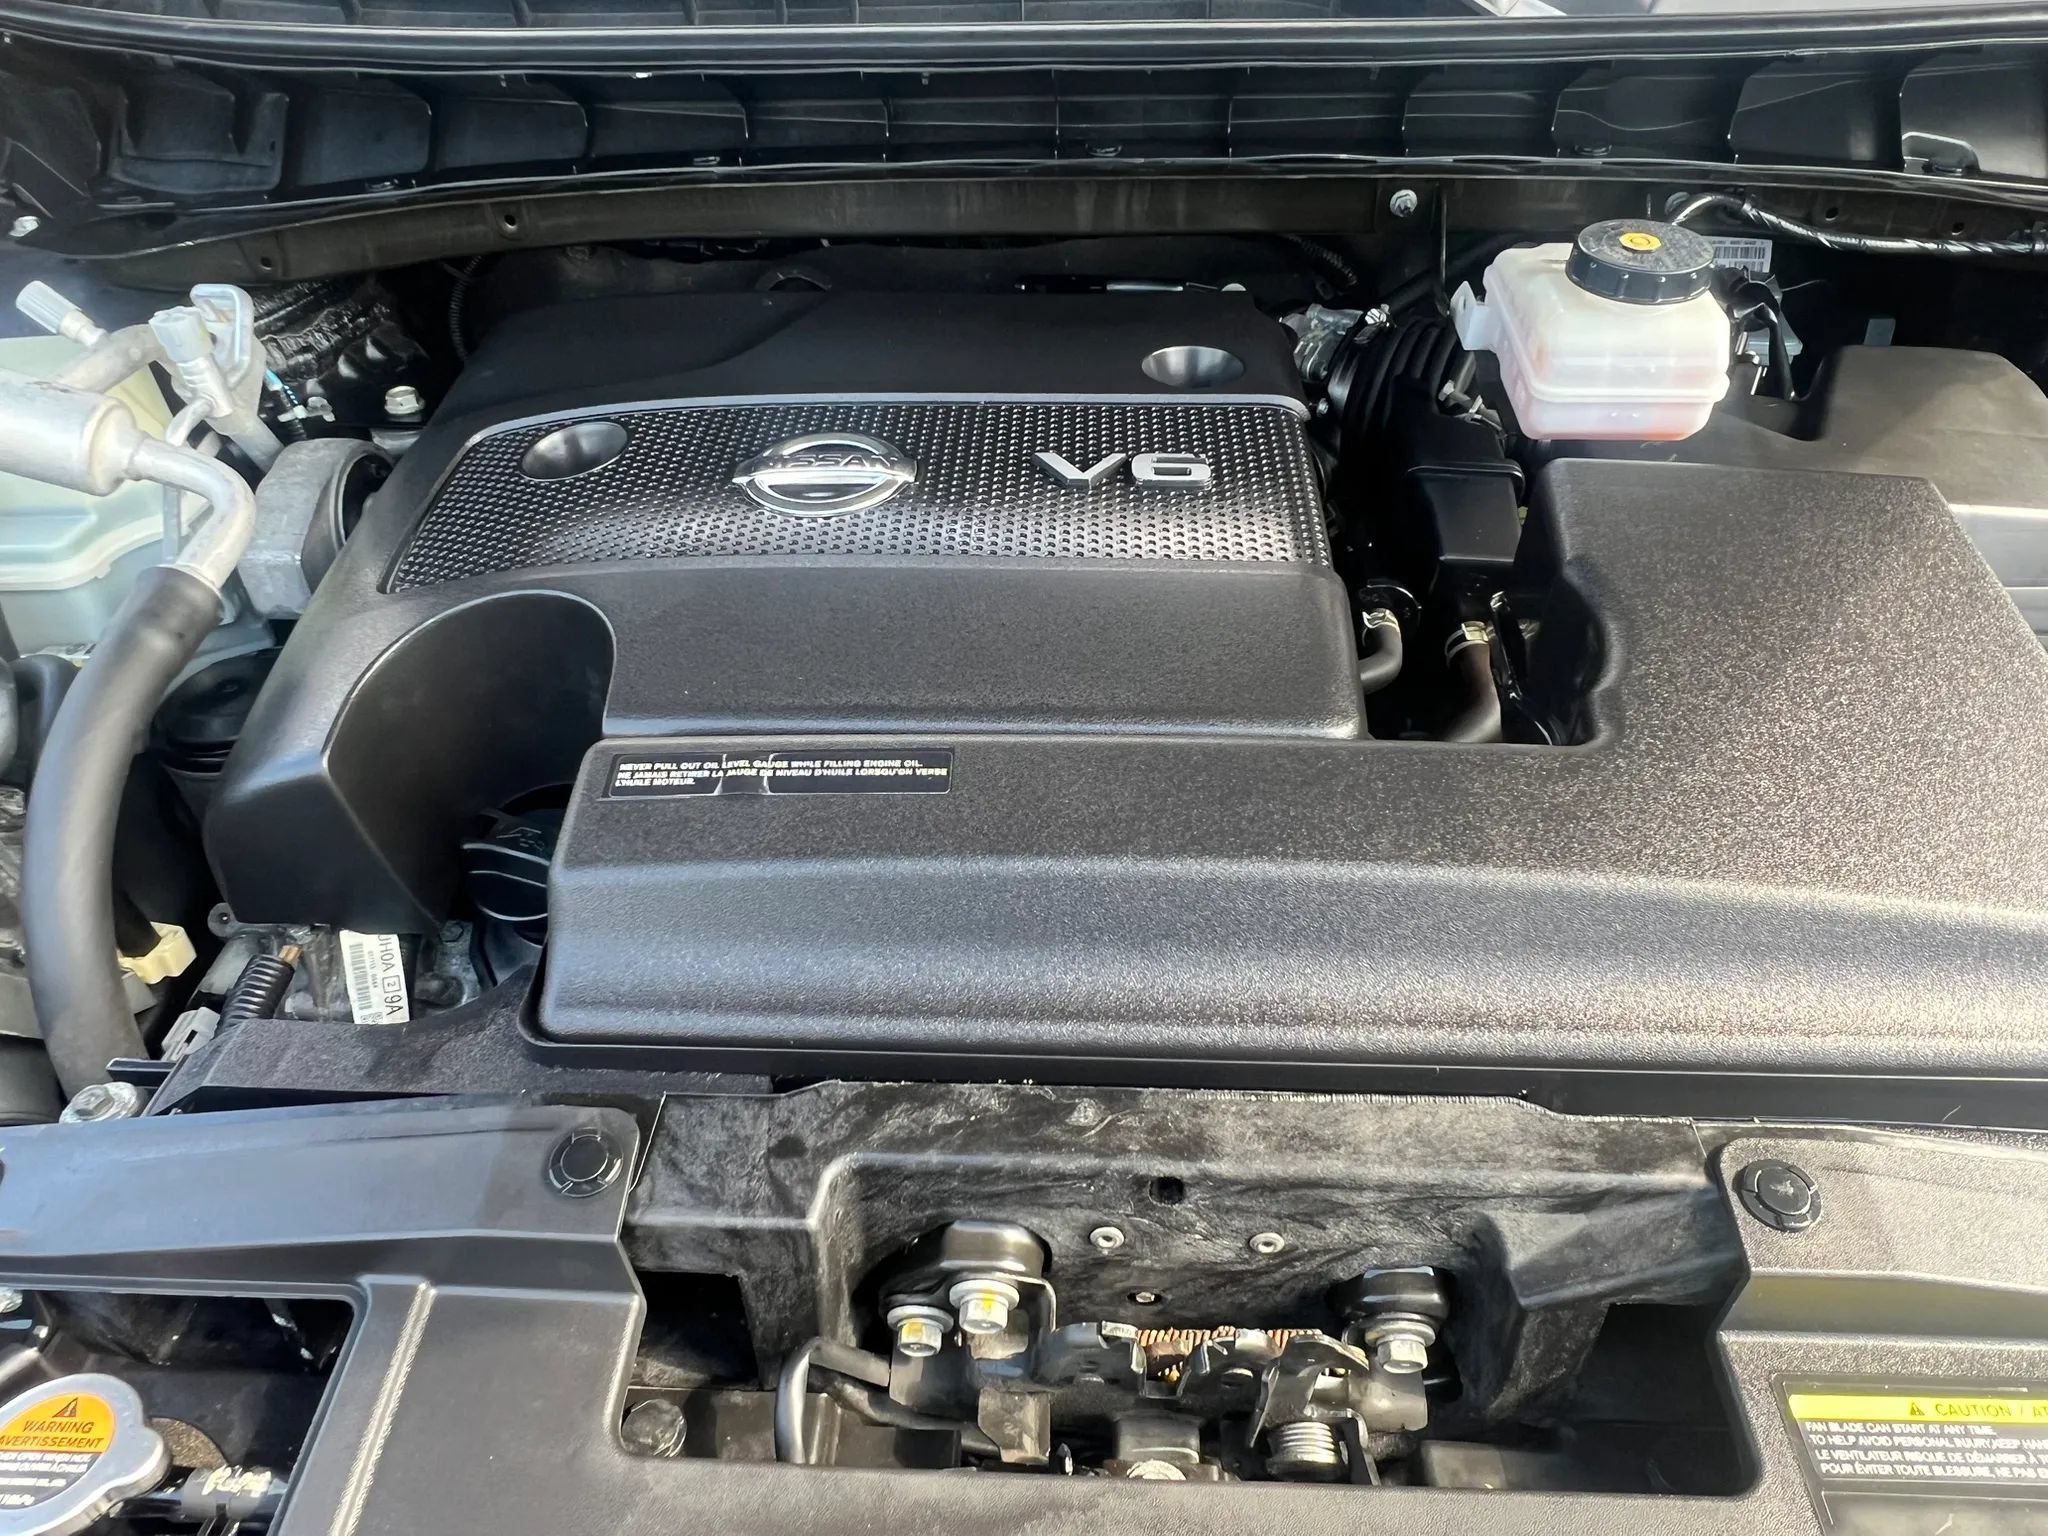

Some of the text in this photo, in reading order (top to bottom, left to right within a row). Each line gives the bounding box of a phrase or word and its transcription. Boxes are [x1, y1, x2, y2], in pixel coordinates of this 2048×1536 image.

[1032, 451, 1213, 489] V6
[619, 763, 652, 771] NEVER
[653, 762, 678, 770] PULL
[680, 762, 701, 770] OUT
[703, 761, 719, 769] OIL
[722, 760, 750, 769] LEVEL
[752, 760, 789, 768] GAUGE
[790, 760, 822, 768] WHILE
[863, 759, 901, 767] ENGINE
[904, 759, 923, 767] OIL.
[617, 771, 632, 779] NE
[633, 771, 667, 779] JAMAIS
[669, 770, 710, 778] RETIRER
[725, 769, 758, 777] JAUGE
[775, 768, 812, 776] NIVEAU
[813, 768, 853, 776] D'HUILE
[855, 768, 913, 776] LORSQU'ON
[916, 767, 948, 776] VERSE
[615, 779, 651, 787] L'HUILE
[384, 994, 404, 1016] 9A
[1935, 1403, 2012, 1417] CAUTION
[22, 1420, 95, 1434] WARNING
[1805, 1422, 1828, 1432] FAN
[1828, 1422, 1865, 1433] BLADE
[1866, 1423, 1891, 1433] CAN
[1891, 1424, 1925, 1434] START
[1928, 1425, 1941, 1434] AT
[1944, 1425, 1966, 1435] ANY
[0, 1435, 105, 1449] AVERTISSEMENT
[1809, 1434, 1826, 1445] TO
[1827, 1435, 1857, 1446] HELP
[1858, 1436, 1893, 1446] AVOID
[1893, 1437, 1954, 1448] PERSONAL
[1993, 1438, 2021, 1449] KEEP
[1815, 1449, 1830, 1460] LE
[1830, 1450, 1904, 1461] VENTILATEUR
[1904, 1452, 1947, 1463] RISQUE
[1947, 1453, 1965, 1463] DE
[1965, 1450, 2028, 1464] DÉMARRER
[1820, 1463, 1855, 1474] POUR
[1855, 1461, 1894, 1475] ÉVITER
[1893, 1465, 1933, 1476] TOUTE
[1932, 1466, 1996, 1478] BLESSURE,
[1995, 1467, 2013, 1478] NE
[2012, 1467, 2036, 1478] PAS
